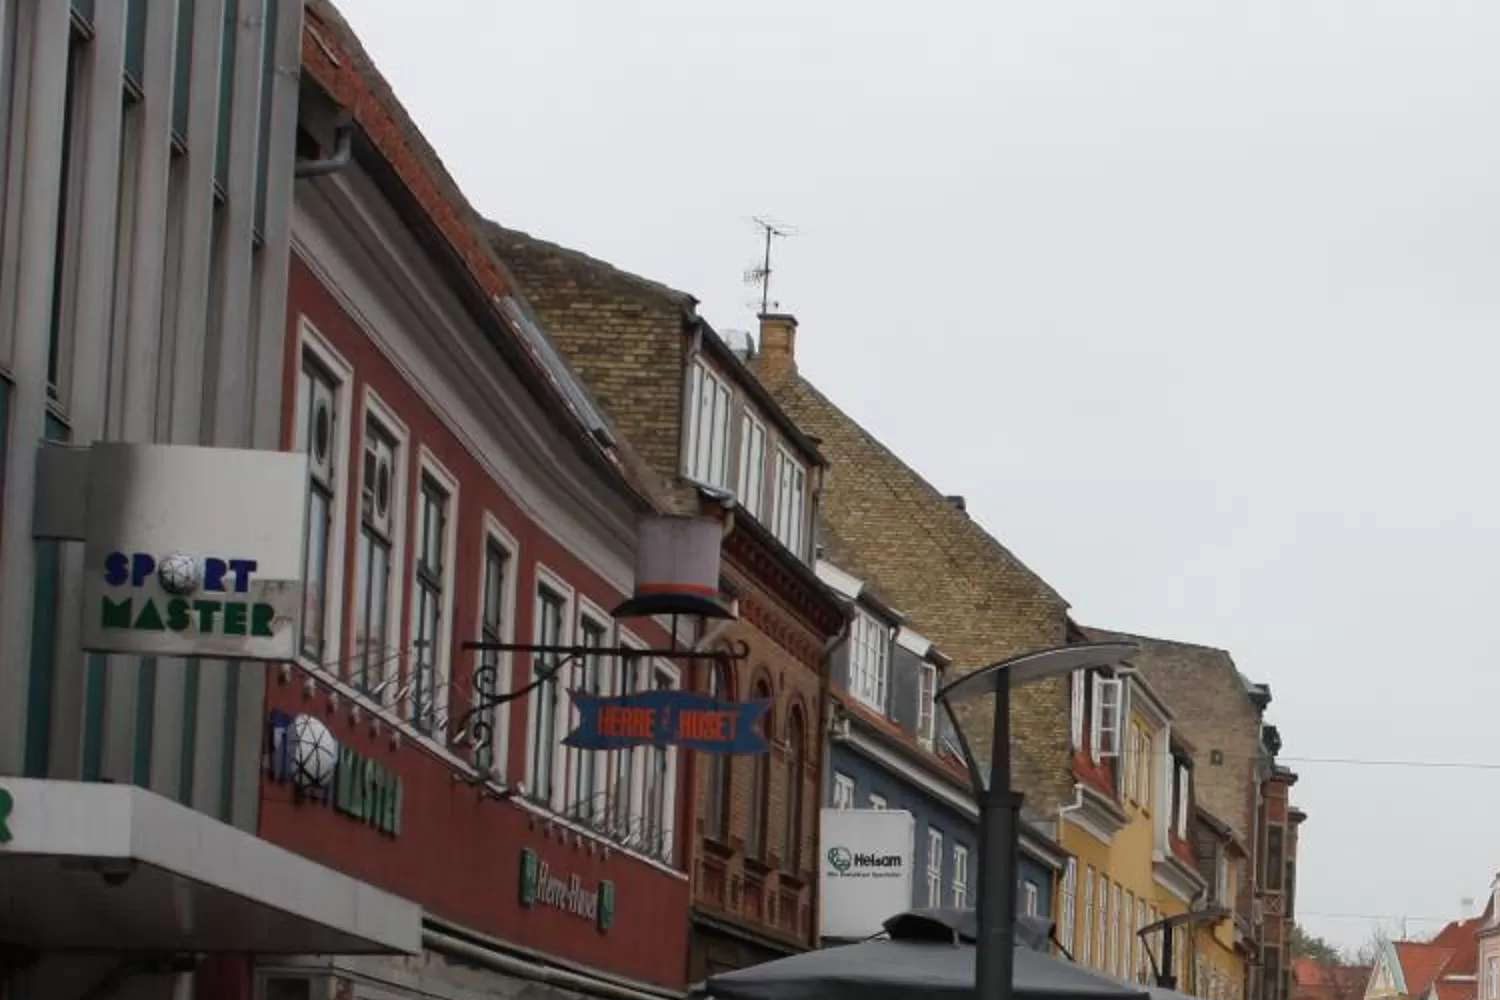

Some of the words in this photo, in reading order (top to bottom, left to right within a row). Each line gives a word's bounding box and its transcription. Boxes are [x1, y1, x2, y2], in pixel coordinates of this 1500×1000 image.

[102, 596, 275, 637] MASTER
[597, 705, 656, 738] HERRE
[679, 709, 738, 741] HUSET
[854, 853, 903, 867] Helsam
